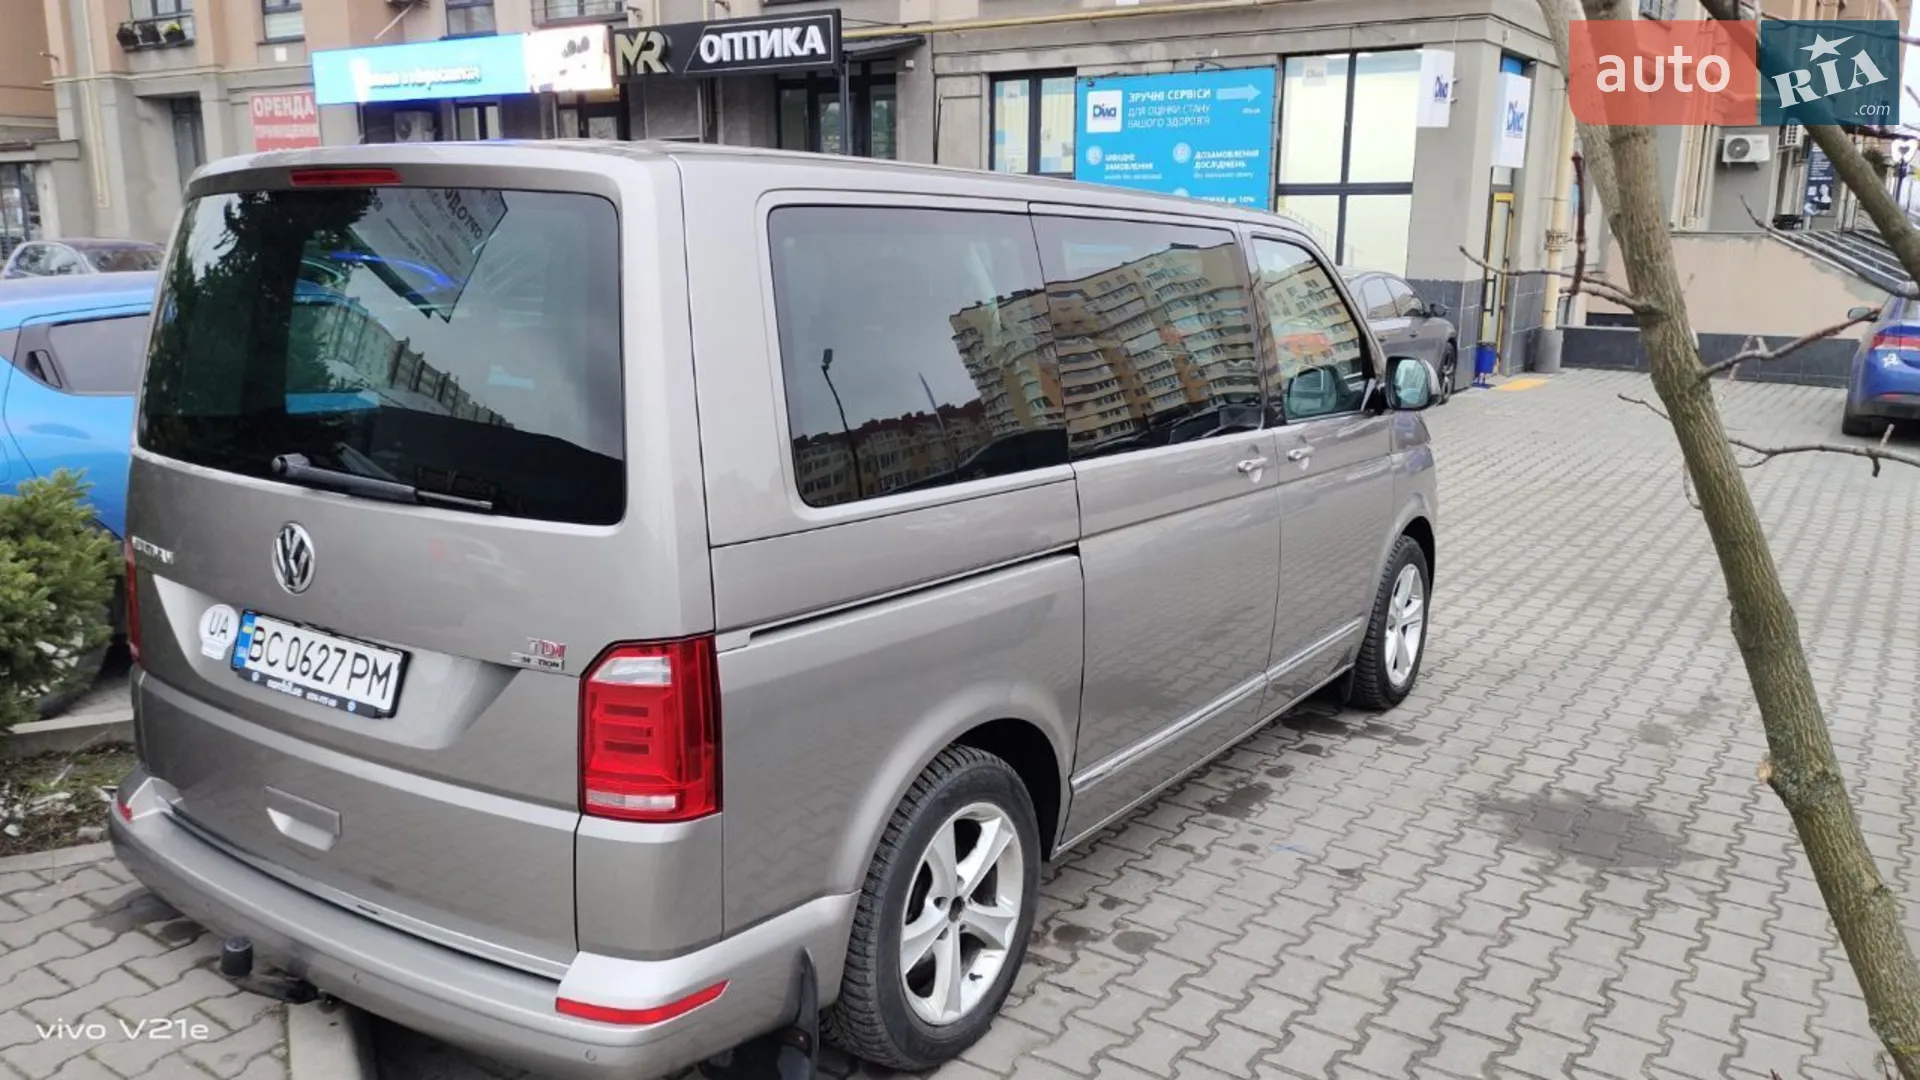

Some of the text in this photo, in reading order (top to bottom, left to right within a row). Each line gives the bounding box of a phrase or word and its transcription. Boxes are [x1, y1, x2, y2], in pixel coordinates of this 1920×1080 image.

[700, 25, 826, 64] ОПТИКА
[1128, 88, 1211, 103] ЗРУЧНІ СЕРВІСИ
[253, 95, 314, 119] ОРЕНДА
[1128, 106, 1146, 117] ДЛЯ
[1128, 118, 1164, 128] ВАШОГО
[208, 612, 229, 640] UA
